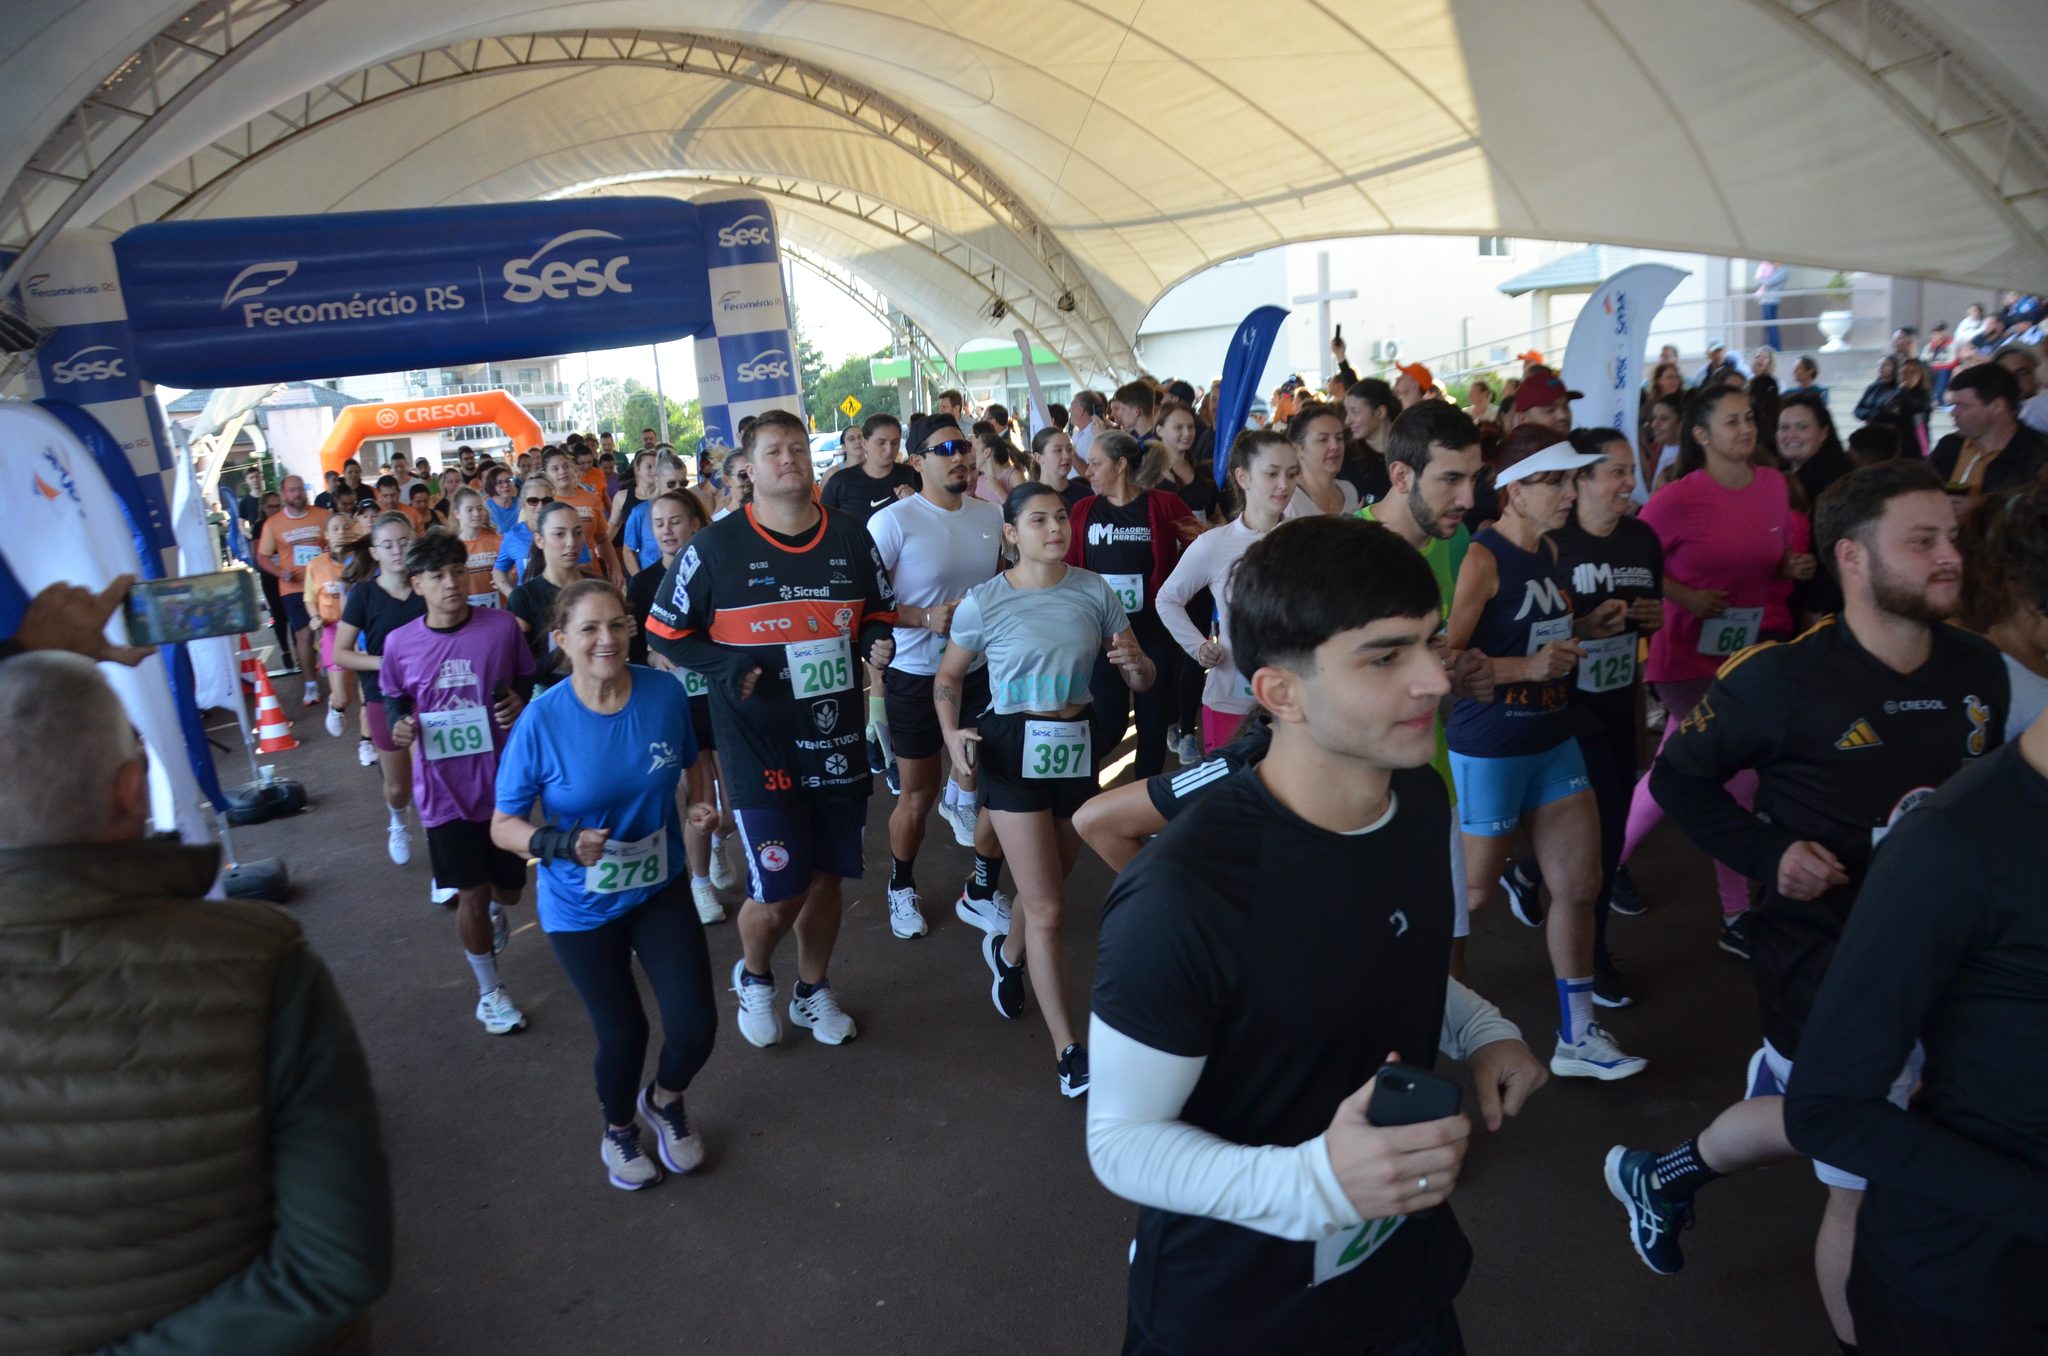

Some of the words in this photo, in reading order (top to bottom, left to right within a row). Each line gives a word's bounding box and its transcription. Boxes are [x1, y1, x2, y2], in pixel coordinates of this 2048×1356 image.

[718, 226, 770, 248] Sesc
[502, 255, 633, 302] Sesc
[243, 290, 417, 328] Fecomércio
[425, 285, 465, 311] RS
[53, 357, 127, 384] Sesc
[737, 360, 790, 382] Sesc
[404, 401, 482, 423] CRESOL
[793, 586, 830, 597] Sicredi
[750, 617, 792, 632] KTO
[1717, 626, 1748, 652] 68
[800, 657, 848, 693] 205
[1589, 653, 1632, 688] 125
[1898, 699, 1948, 711] CRESOL
[432, 725, 483, 753] 169
[795, 739, 833, 750] VENCE
[833, 733, 859, 746] TUDO
[1032, 729, 1052, 737] Sesc
[1033, 743, 1085, 774] 397
[763, 768, 792, 791] 36
[597, 854, 660, 889] 278
[975, 856, 988, 887] RUN
